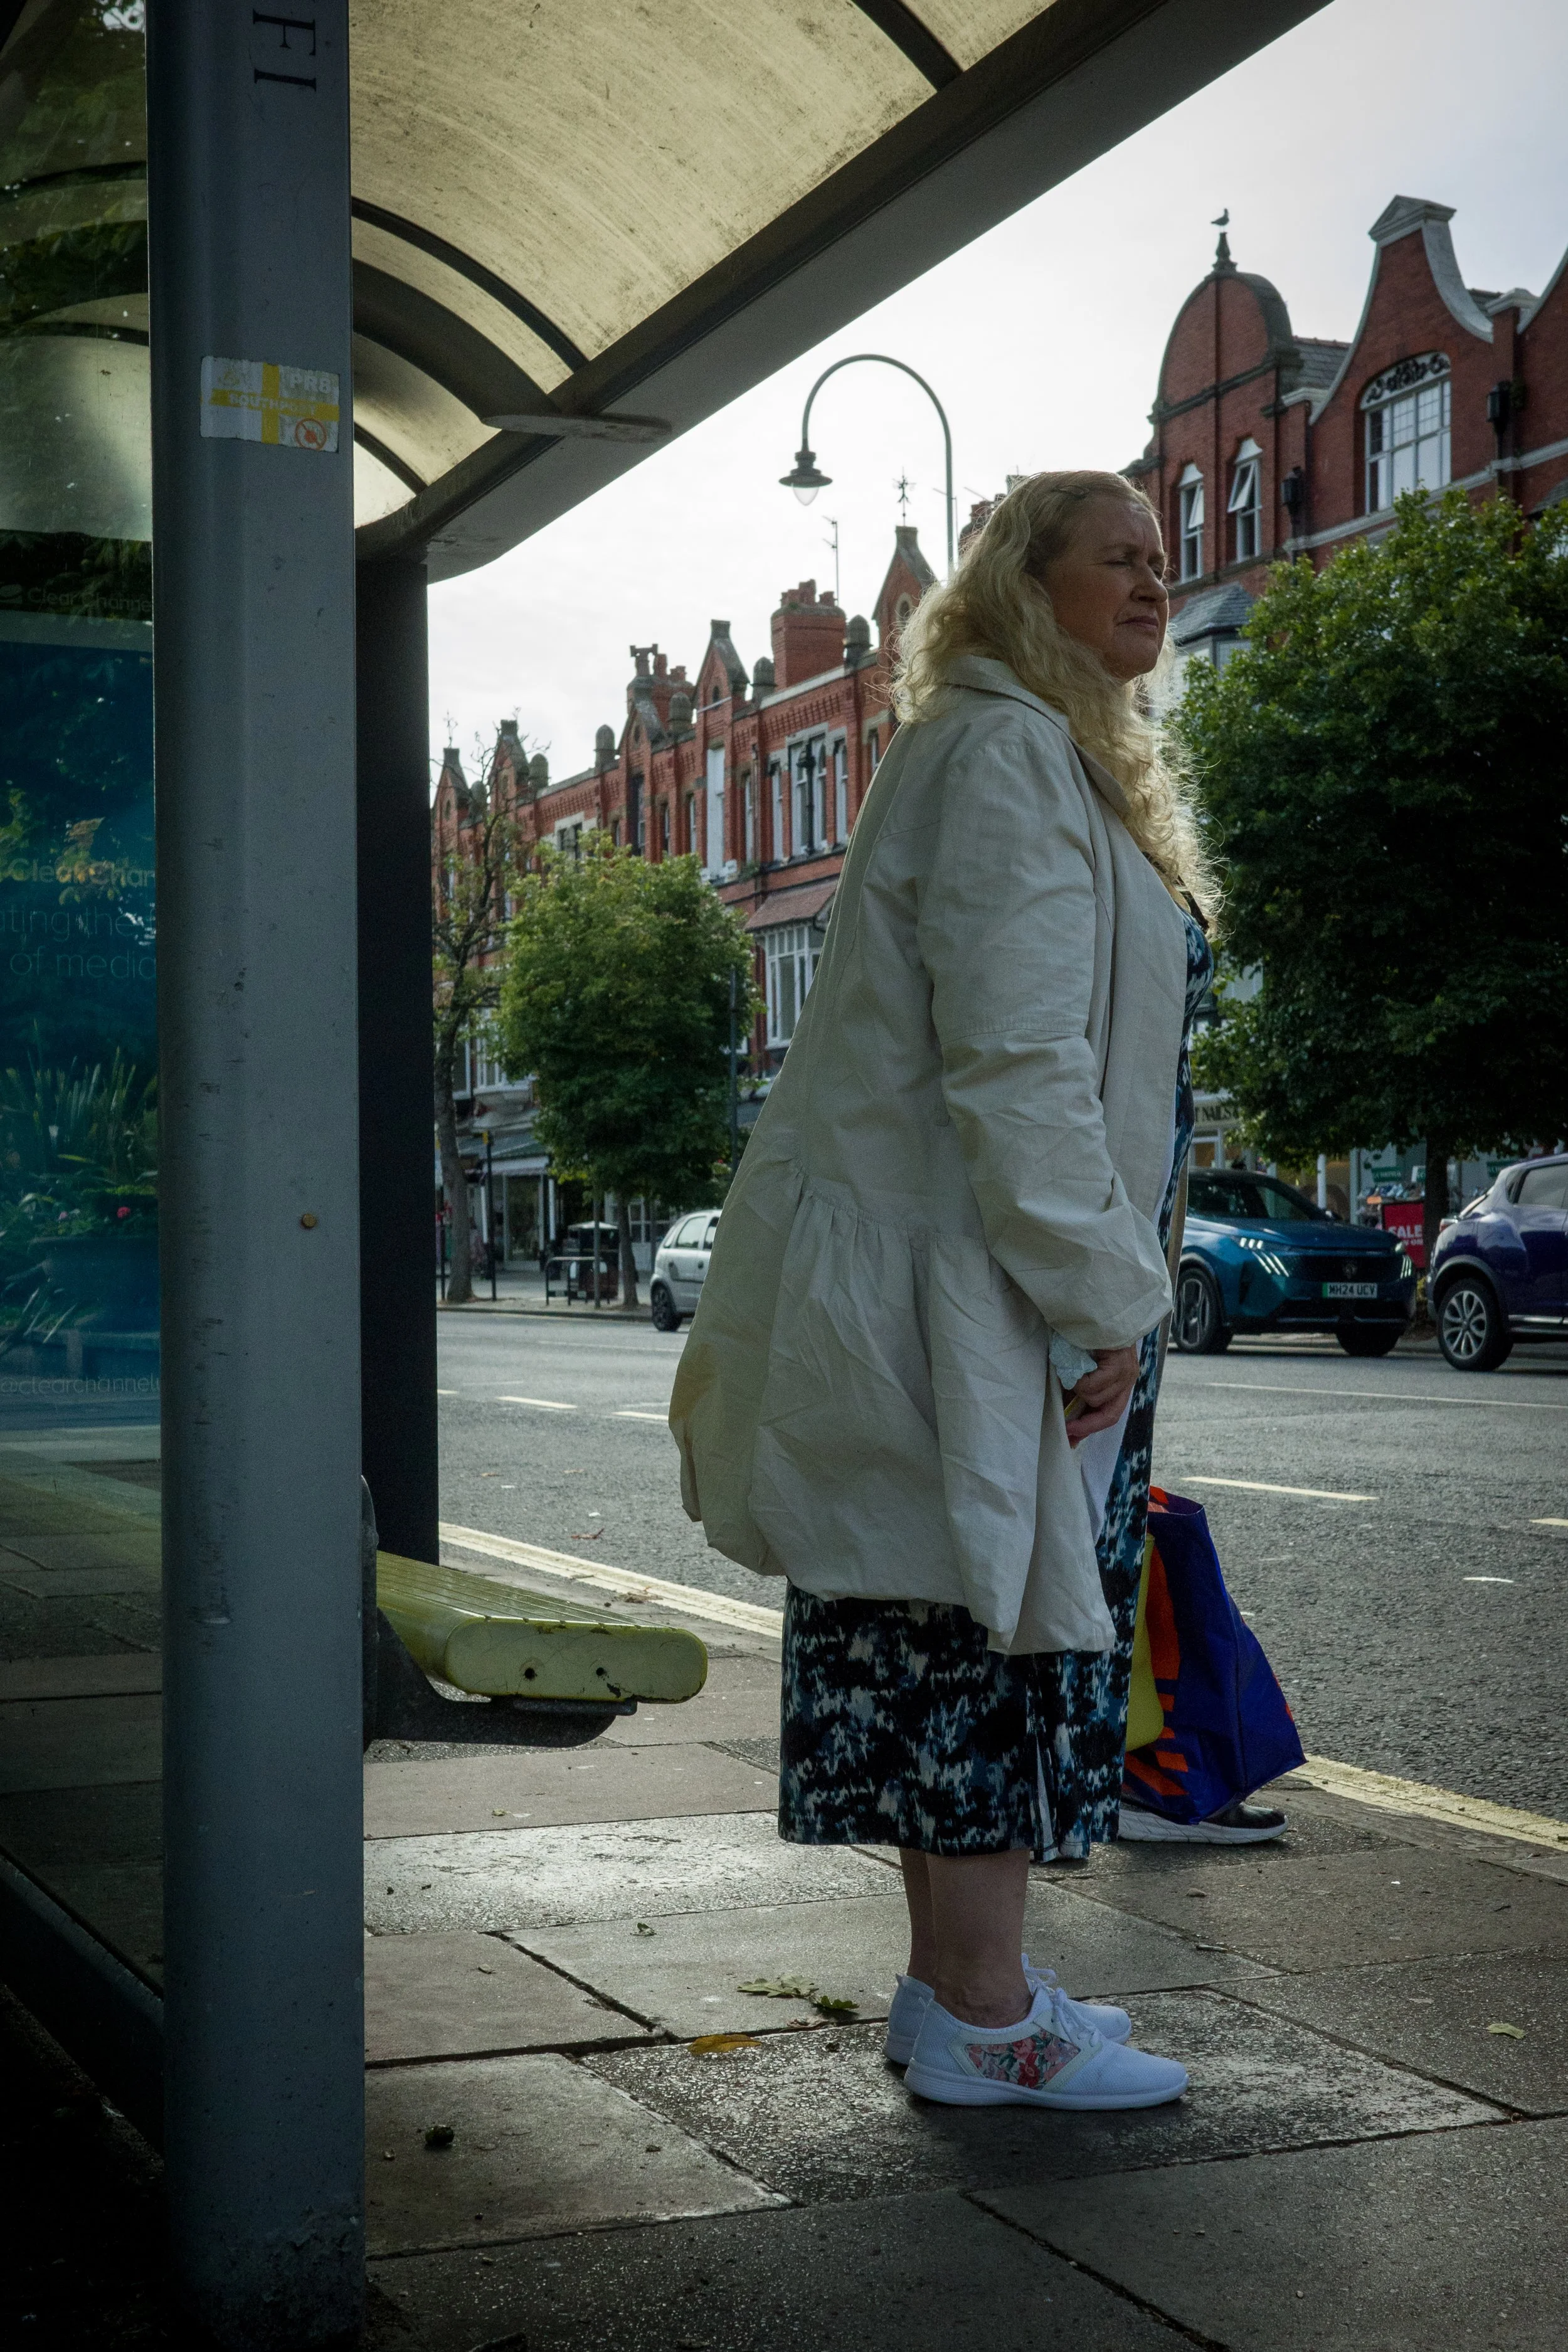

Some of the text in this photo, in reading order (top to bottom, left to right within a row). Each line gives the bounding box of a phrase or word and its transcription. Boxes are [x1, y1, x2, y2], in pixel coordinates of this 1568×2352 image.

[290, 373, 331, 393] PR8
[27, 586, 79, 606] Clear
[10, 946, 45, 975] of
[1201, 1106, 1231, 1121] NAILS
[1388, 1224, 1422, 1239] SALE
